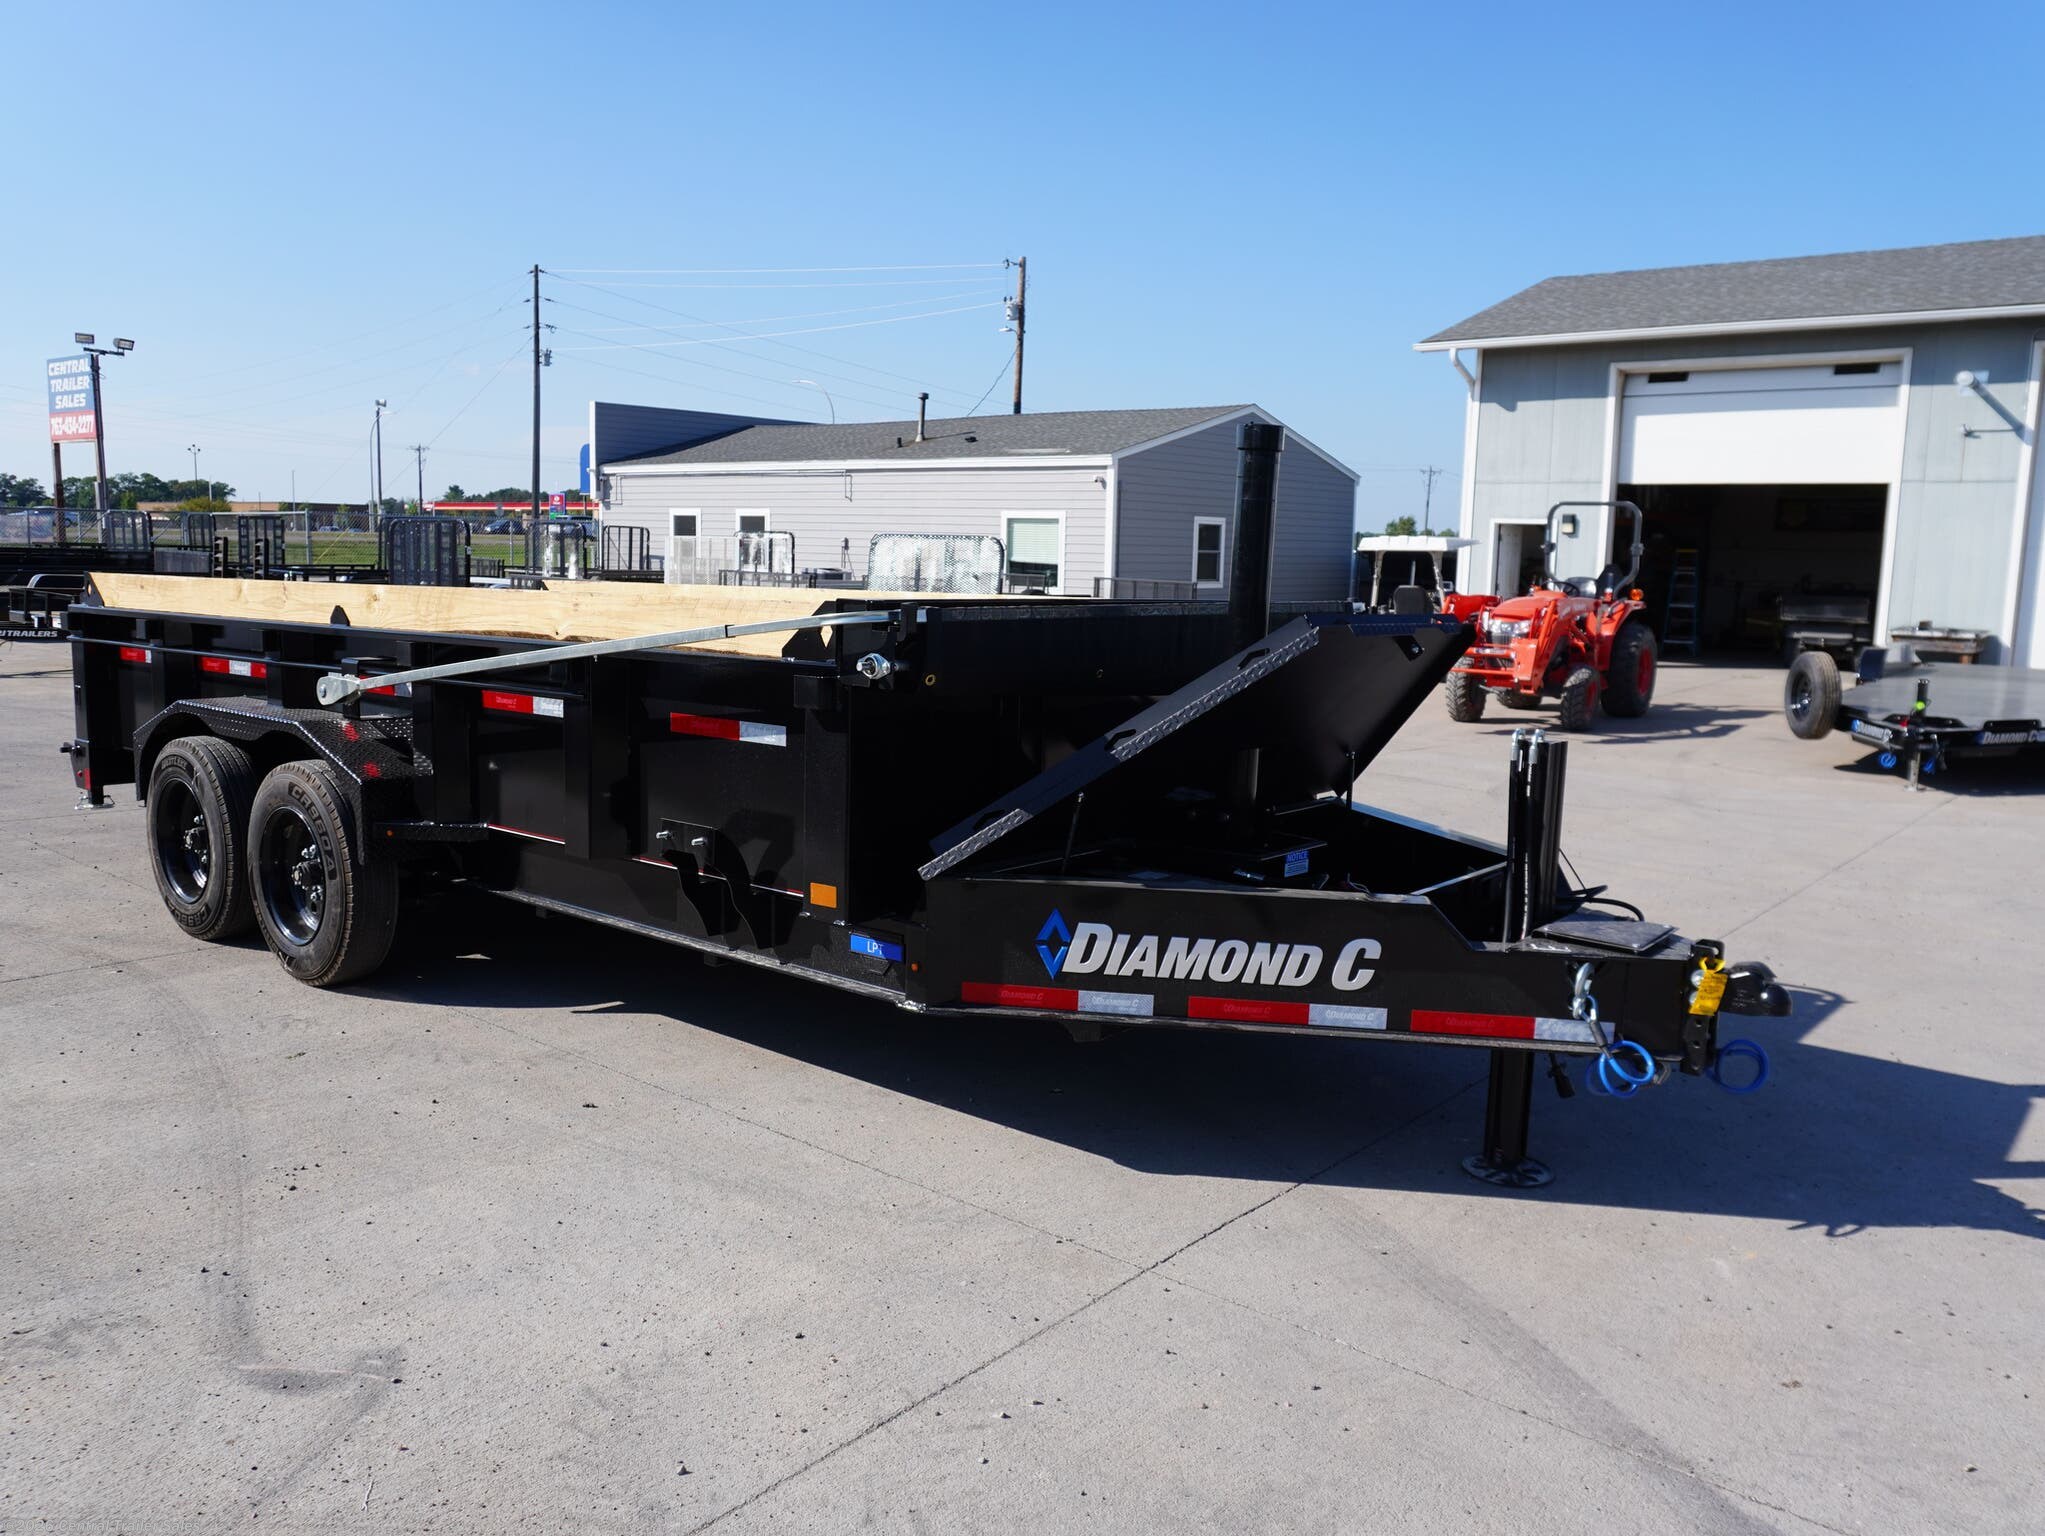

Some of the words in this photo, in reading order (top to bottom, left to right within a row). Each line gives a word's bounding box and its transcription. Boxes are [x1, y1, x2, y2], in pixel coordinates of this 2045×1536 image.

[48, 358, 91, 376] CENTRAL
[50, 375, 90, 392] TRAILER
[55, 393, 86, 409] SALES
[1983, 731, 2028, 745] DIAMOND
[291, 784, 335, 872] CR960A
[1286, 850, 1309, 862] NOTICE
[1061, 922, 1323, 987] DIAMOND
[1331, 938, 1382, 991] C
